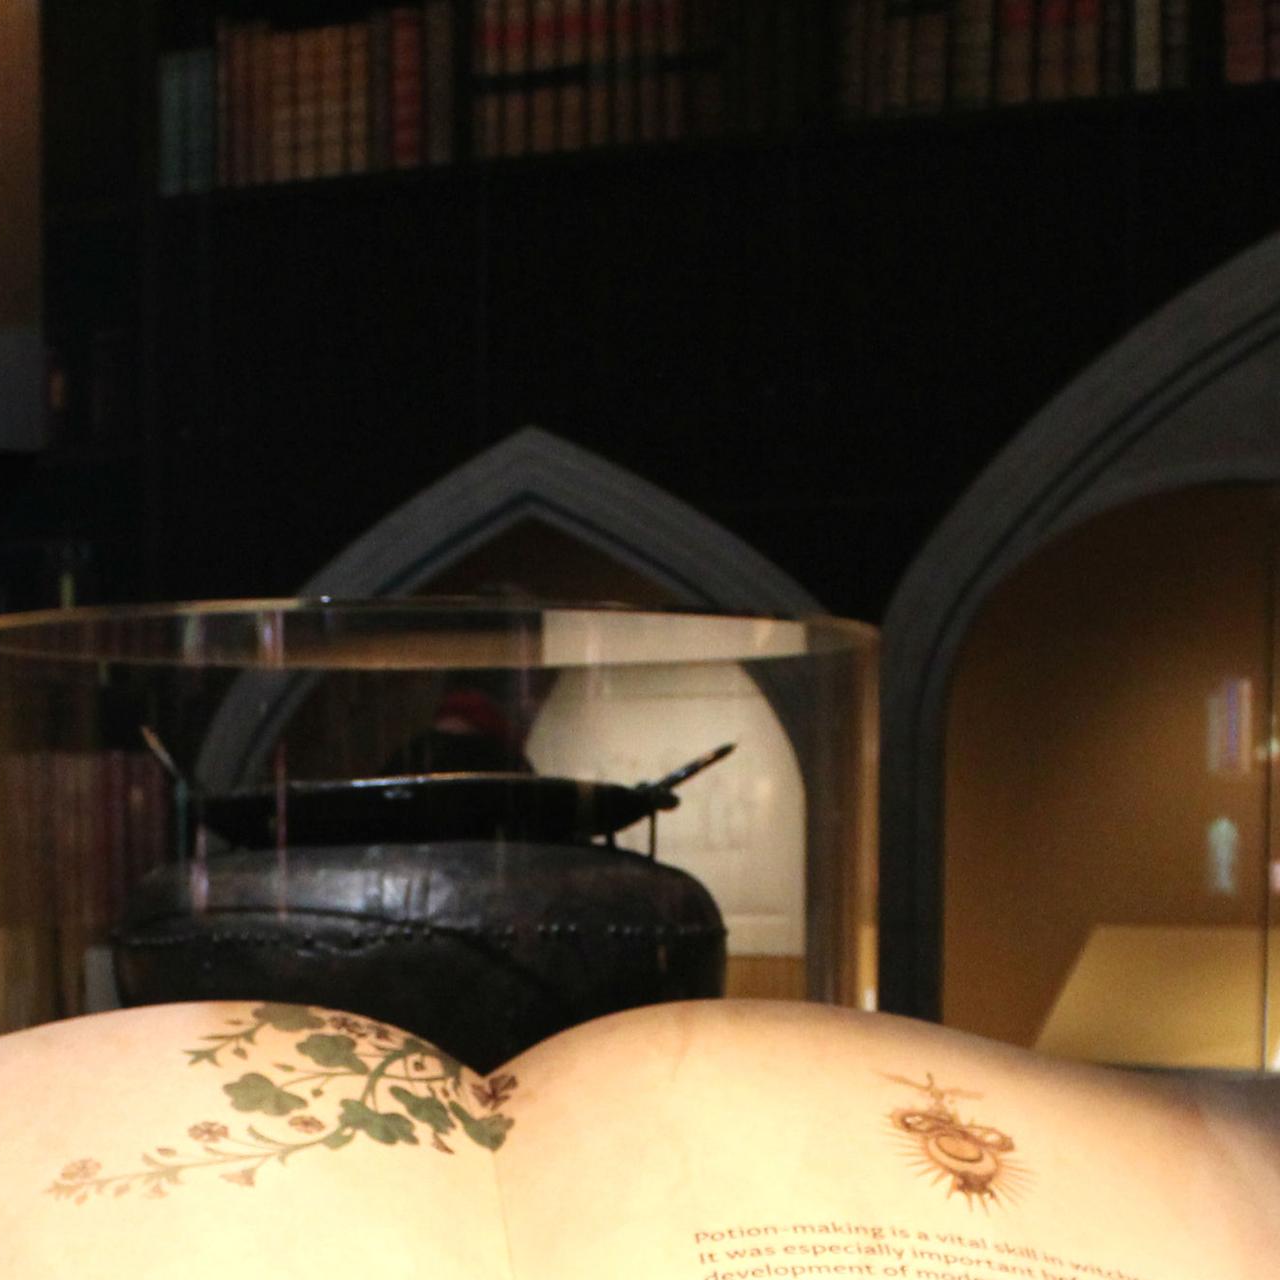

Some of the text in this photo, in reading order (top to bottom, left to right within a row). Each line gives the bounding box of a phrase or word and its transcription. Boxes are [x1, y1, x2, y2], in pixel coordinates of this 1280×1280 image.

[694, 1222, 885, 1244] Potion-making
[890, 1226, 911, 1240] is
[916, 1231, 929, 1242] a
[936, 1232, 987, 1249] vital
[993, 1241, 1038, 1260] skill
[1042, 1251, 1064, 1265] in
[699, 1251, 719, 1265] It
[725, 1245, 777, 1260] was
[782, 1243, 905, 1260] especially
[911, 1246, 1035, 1278] important
[882, 1263, 909, 1278] of
